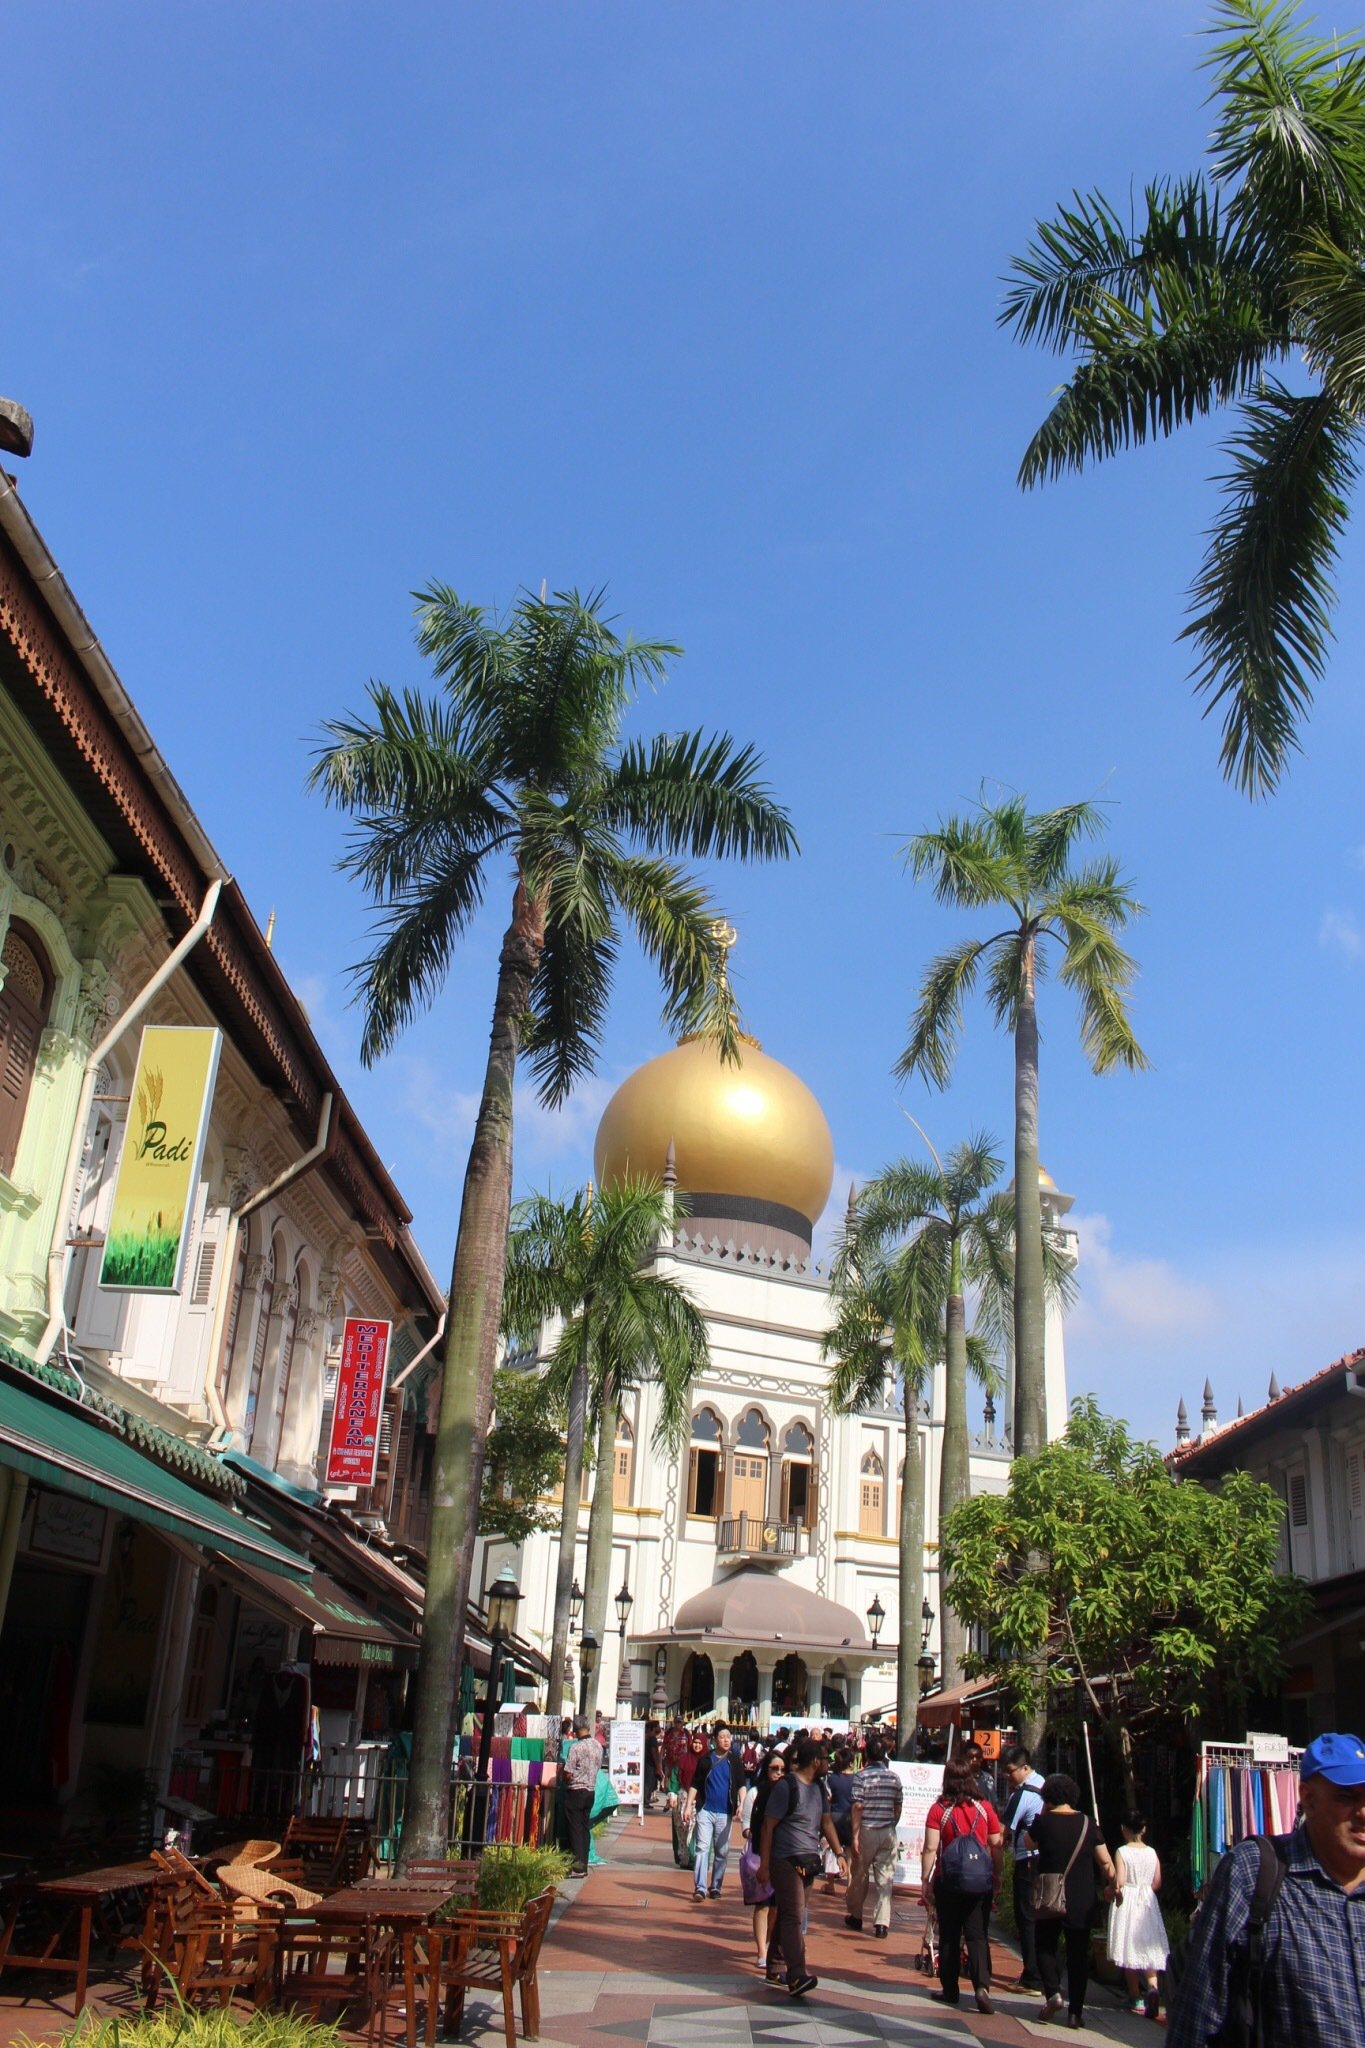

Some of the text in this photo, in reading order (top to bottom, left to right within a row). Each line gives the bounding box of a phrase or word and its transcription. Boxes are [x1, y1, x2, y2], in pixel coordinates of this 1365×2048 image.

[140, 1121, 192, 1161] Padi
[345, 1324, 378, 1447] MEDITERRANEAN
[982, 1747, 995, 1756] HOP
